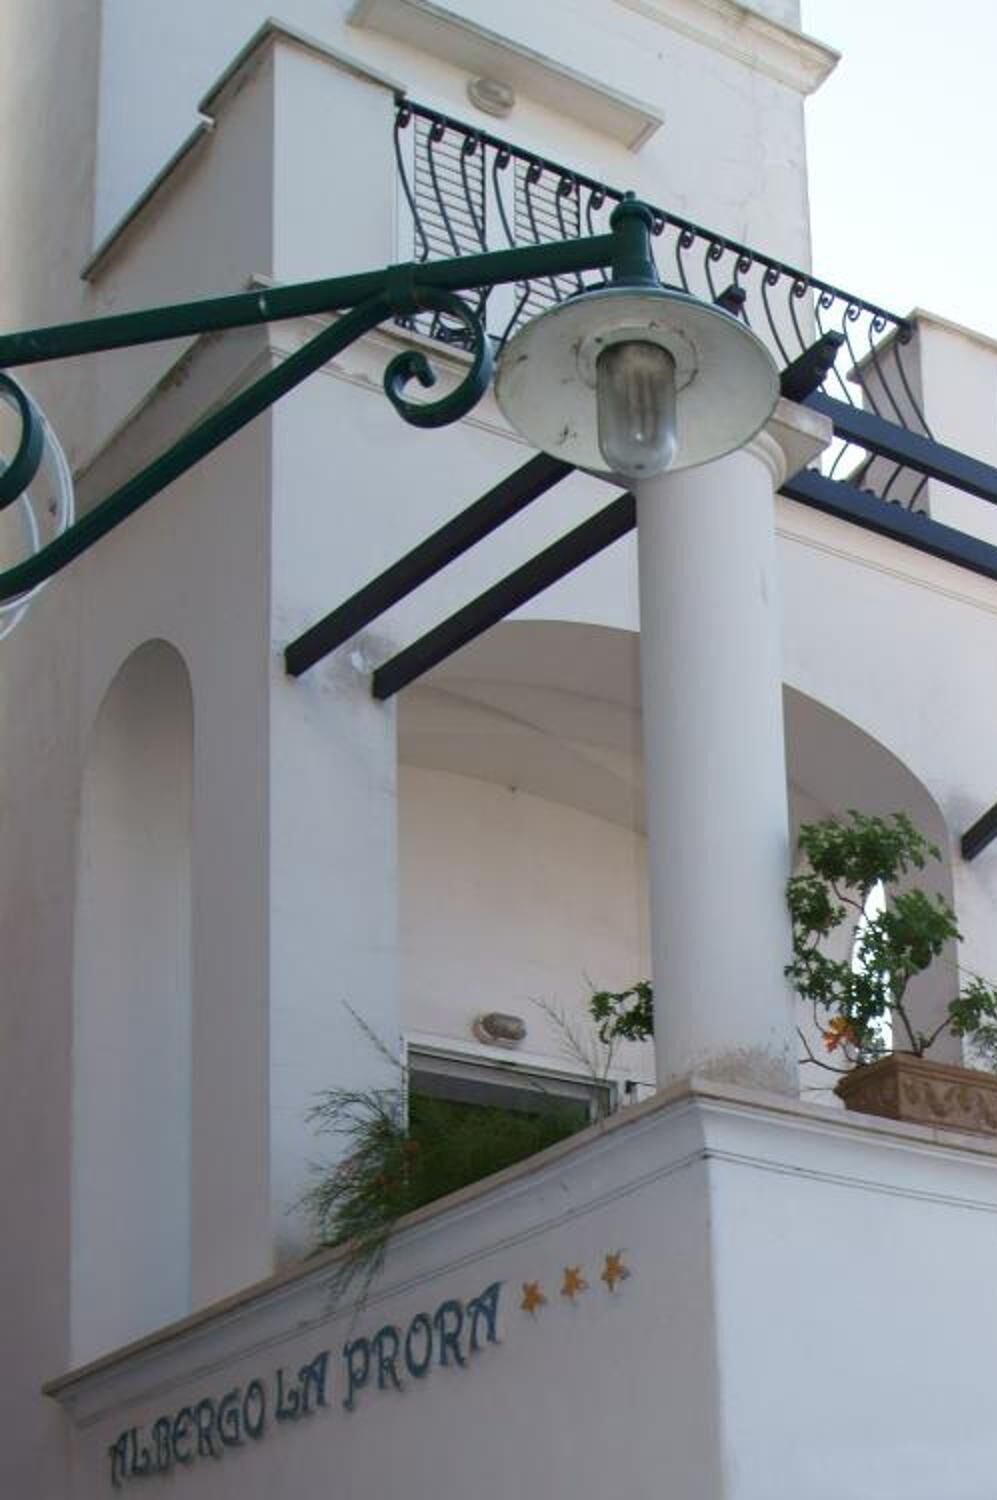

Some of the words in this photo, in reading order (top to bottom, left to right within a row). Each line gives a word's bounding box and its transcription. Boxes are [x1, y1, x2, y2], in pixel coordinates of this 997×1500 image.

[108, 1376, 267, 1489] ALBERGO
[274, 1349, 330, 1422] LA
[340, 1280, 506, 1411] PRORA
